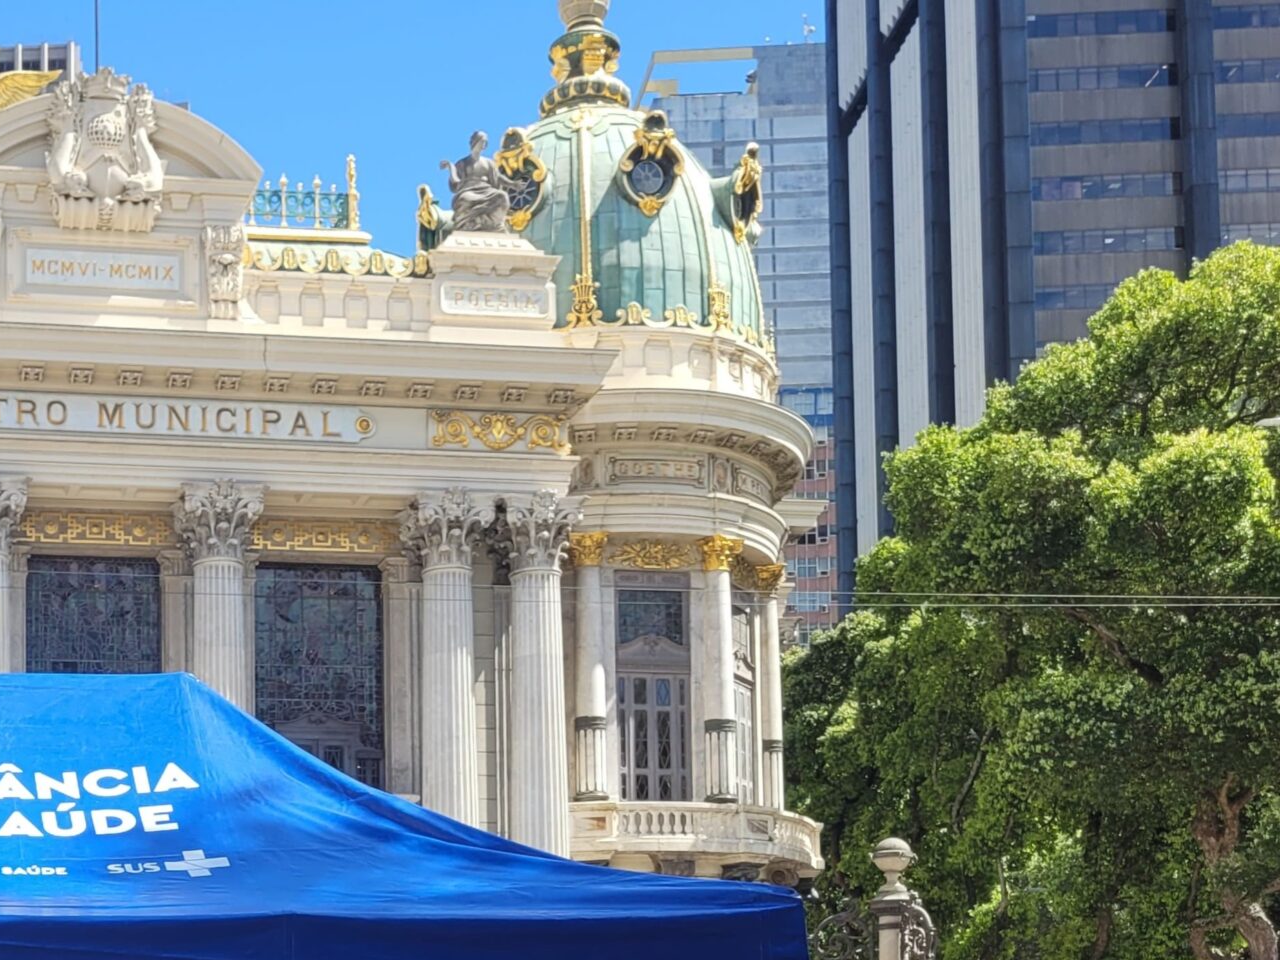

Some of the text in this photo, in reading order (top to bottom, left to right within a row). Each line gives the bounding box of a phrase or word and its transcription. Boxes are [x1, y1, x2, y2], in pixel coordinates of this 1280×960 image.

[31, 258, 175, 281] MCMVI-MCMIX
[453, 291, 536, 309] POESIA
[97, 400, 342, 438] MUNICIPAL
[0, 864, 69, 876] SAÚDE
[107, 861, 161, 875] SUS
